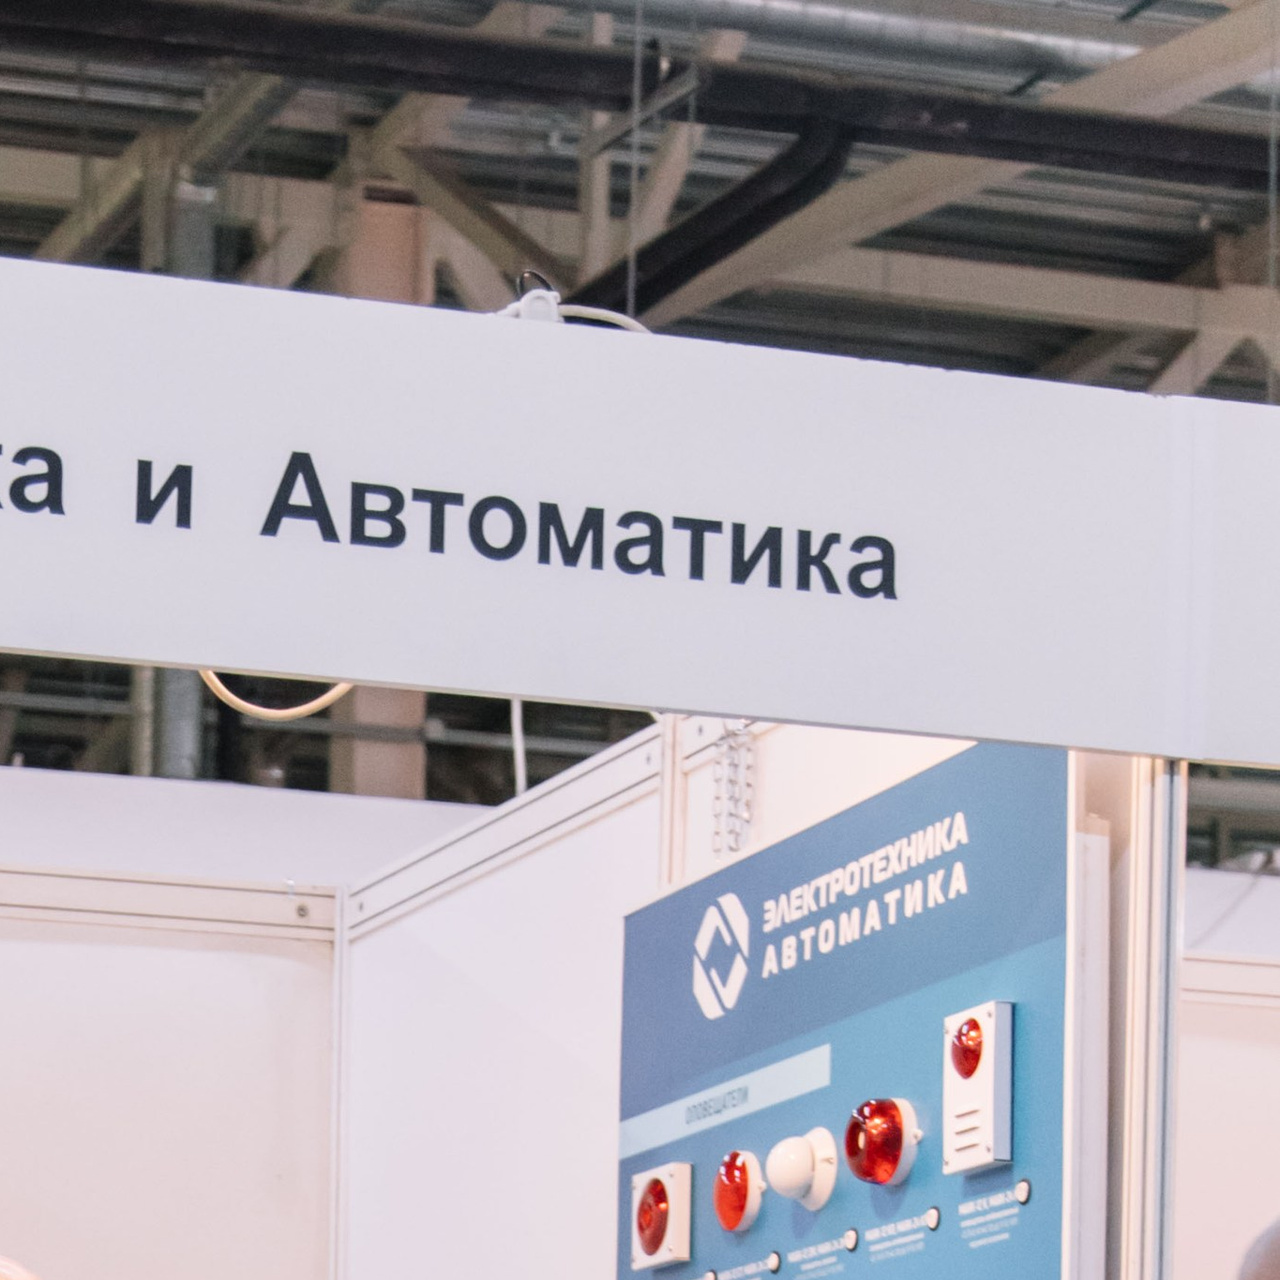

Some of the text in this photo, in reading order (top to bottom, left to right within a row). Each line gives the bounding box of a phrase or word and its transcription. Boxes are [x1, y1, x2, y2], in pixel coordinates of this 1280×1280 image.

[134, 459, 194, 530] и
[260, 451, 899, 600] Автоматика
[761, 861, 968, 979] АВТОМАТИКА
[762, 811, 969, 933] ЭЛЕКТРОТЕХНИКА
